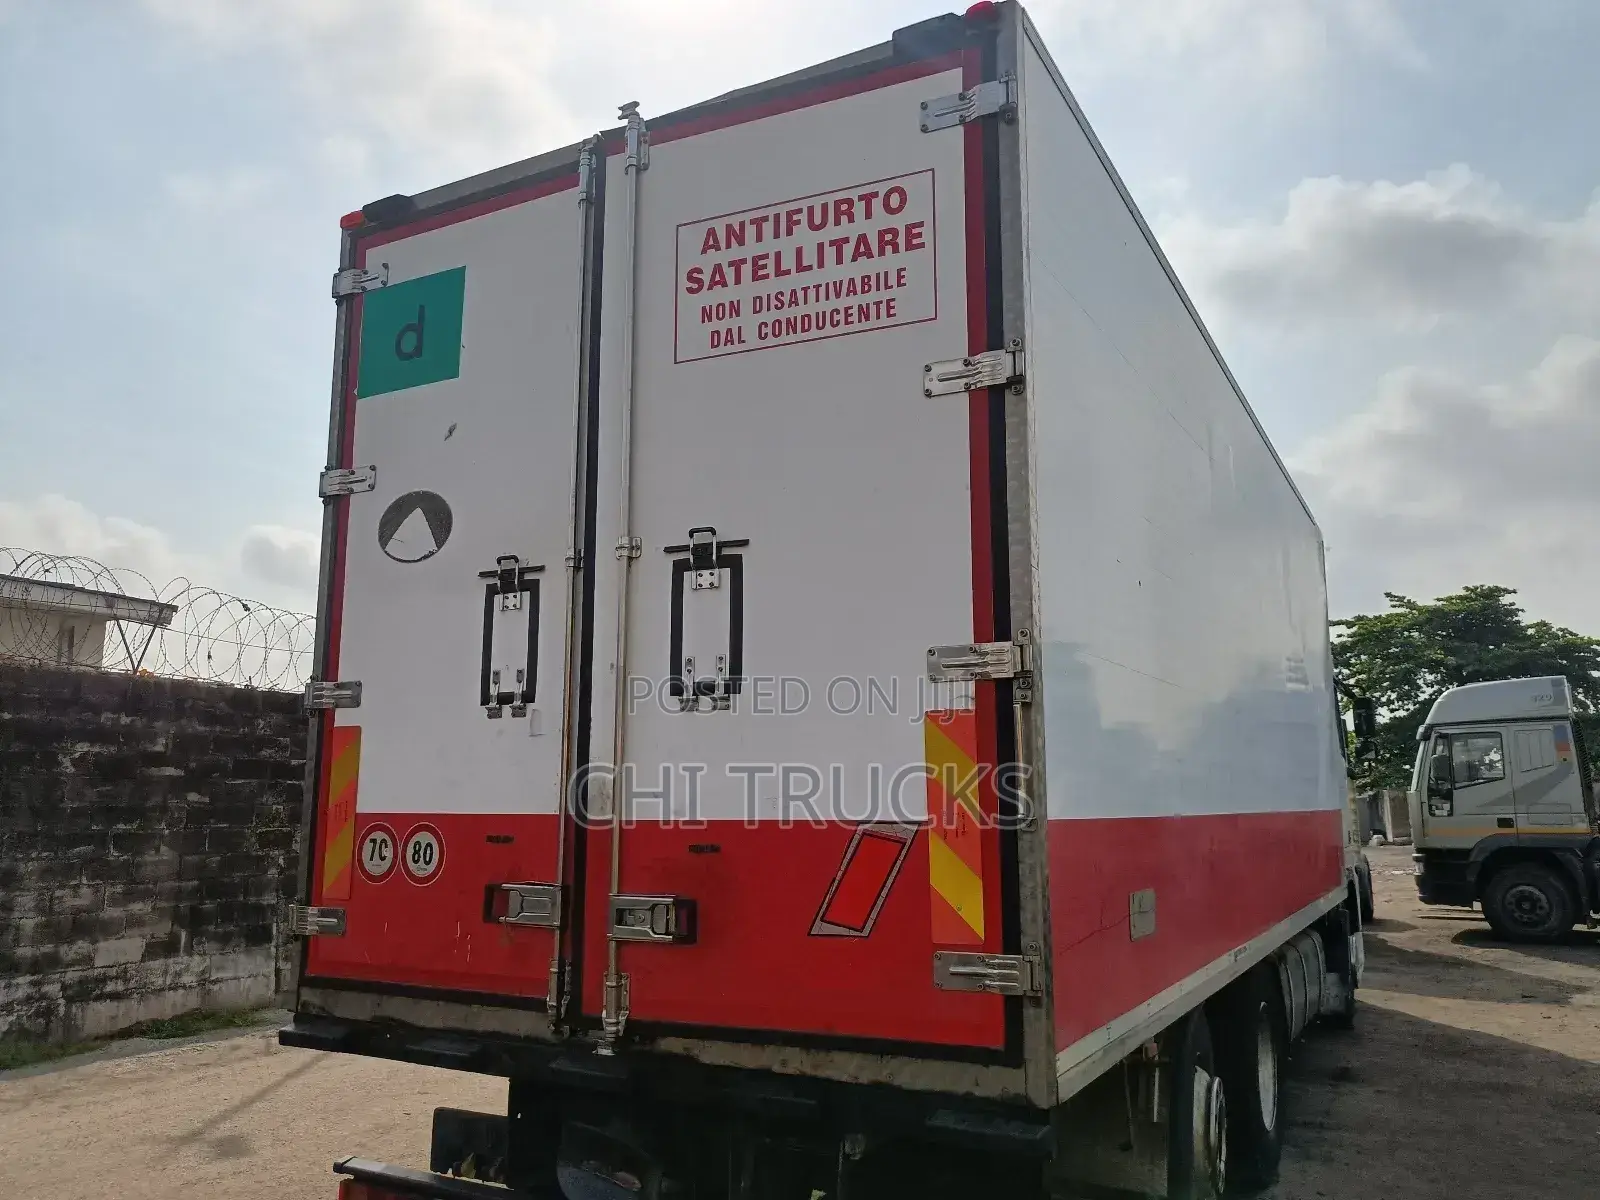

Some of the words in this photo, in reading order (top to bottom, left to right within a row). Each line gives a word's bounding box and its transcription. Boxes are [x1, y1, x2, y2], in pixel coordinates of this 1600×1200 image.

[701, 185, 907, 255] ANTIFURTO
[685, 221, 925, 294] SATELLITARE
[701, 299, 741, 324] NON
[753, 267, 907, 315] DISATTIVABILE
[711, 326, 746, 349] DAL
[758, 298, 896, 341] CONDUCENTE
[395, 304, 425, 361] d
[412, 841, 434, 866] 80
